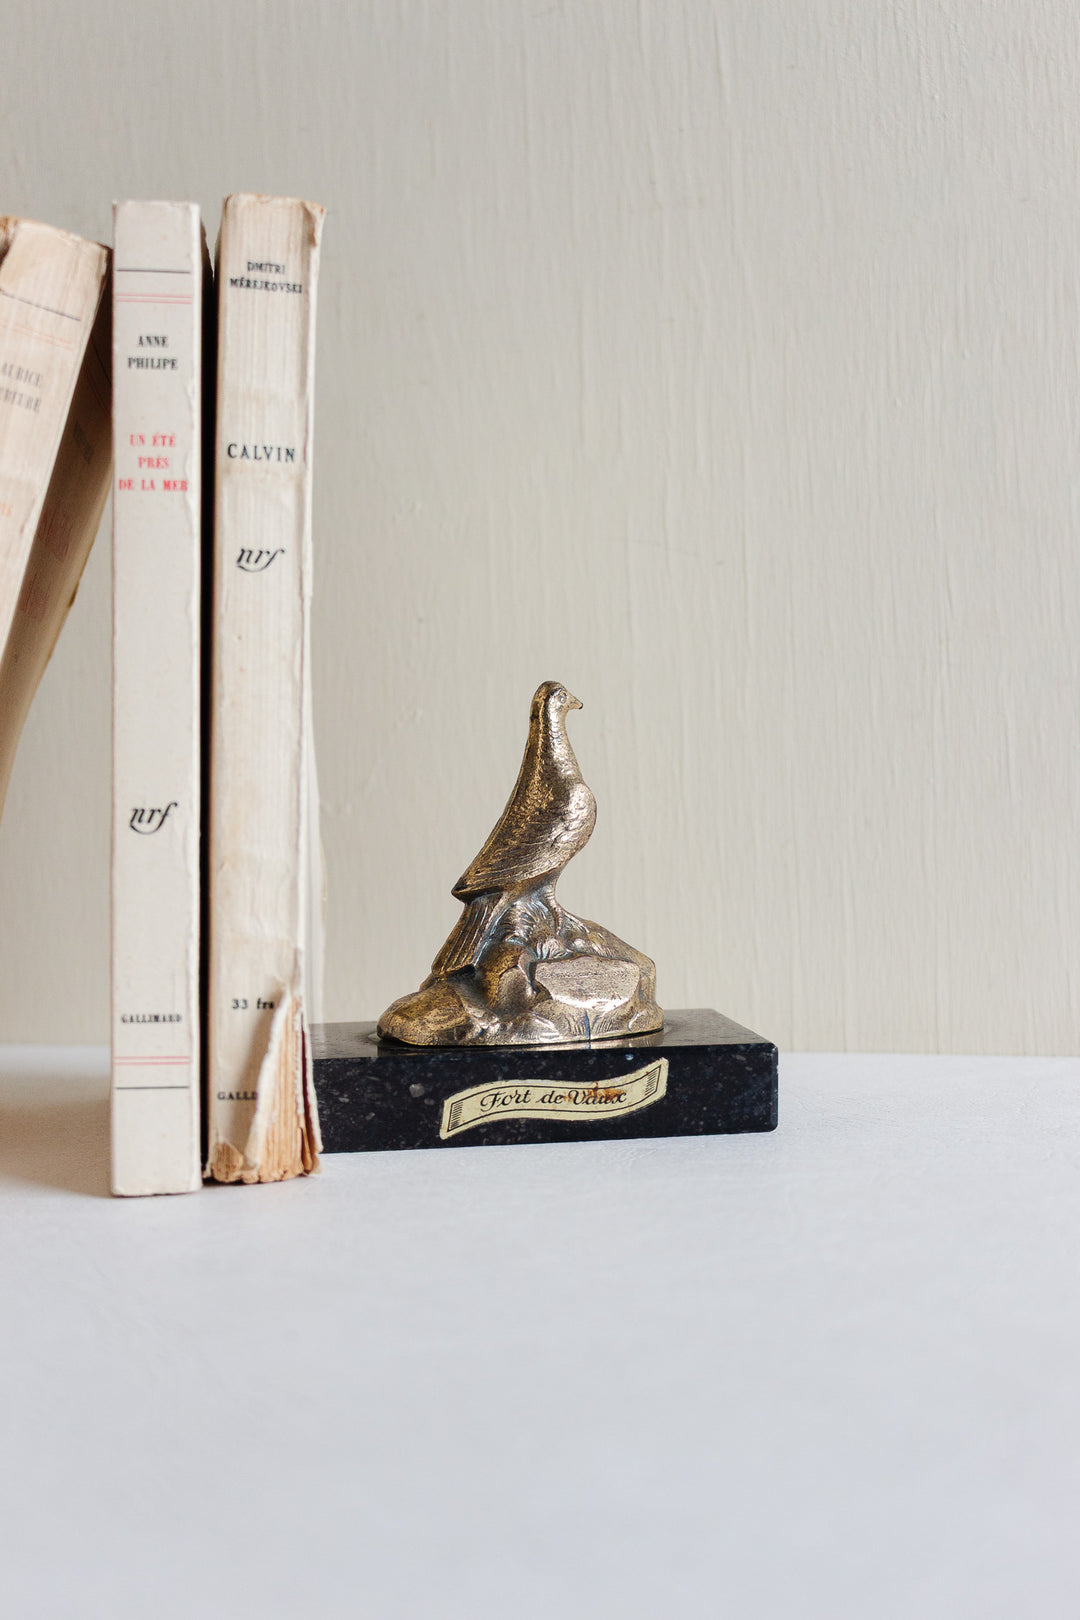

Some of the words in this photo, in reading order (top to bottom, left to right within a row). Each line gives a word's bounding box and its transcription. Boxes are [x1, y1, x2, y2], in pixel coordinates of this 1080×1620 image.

[246, 260, 286, 275] DMITRI
[136, 335, 169, 348] ANNE
[127, 356, 178, 371] PHILIPE
[2, 362, 44, 388] AURICE
[129, 433, 146, 447] UN
[151, 432, 177, 448] ÉTÉ
[227, 443, 295, 462] CALVIN
[118, 478, 134, 491] DE
[140, 478, 156, 491] LA
[162, 479, 188, 492] MER
[236, 547, 286, 572] nrf
[129, 801, 179, 834] nrf
[231, 998, 249, 1010] 33
[120, 1013, 182, 1024] GALLIMARD
[217, 1091, 257, 1101] GALLI
[479, 1089, 532, 1113] Fort
[534, 1089, 565, 1105] de
[567, 1089, 628, 1106] Vaux
